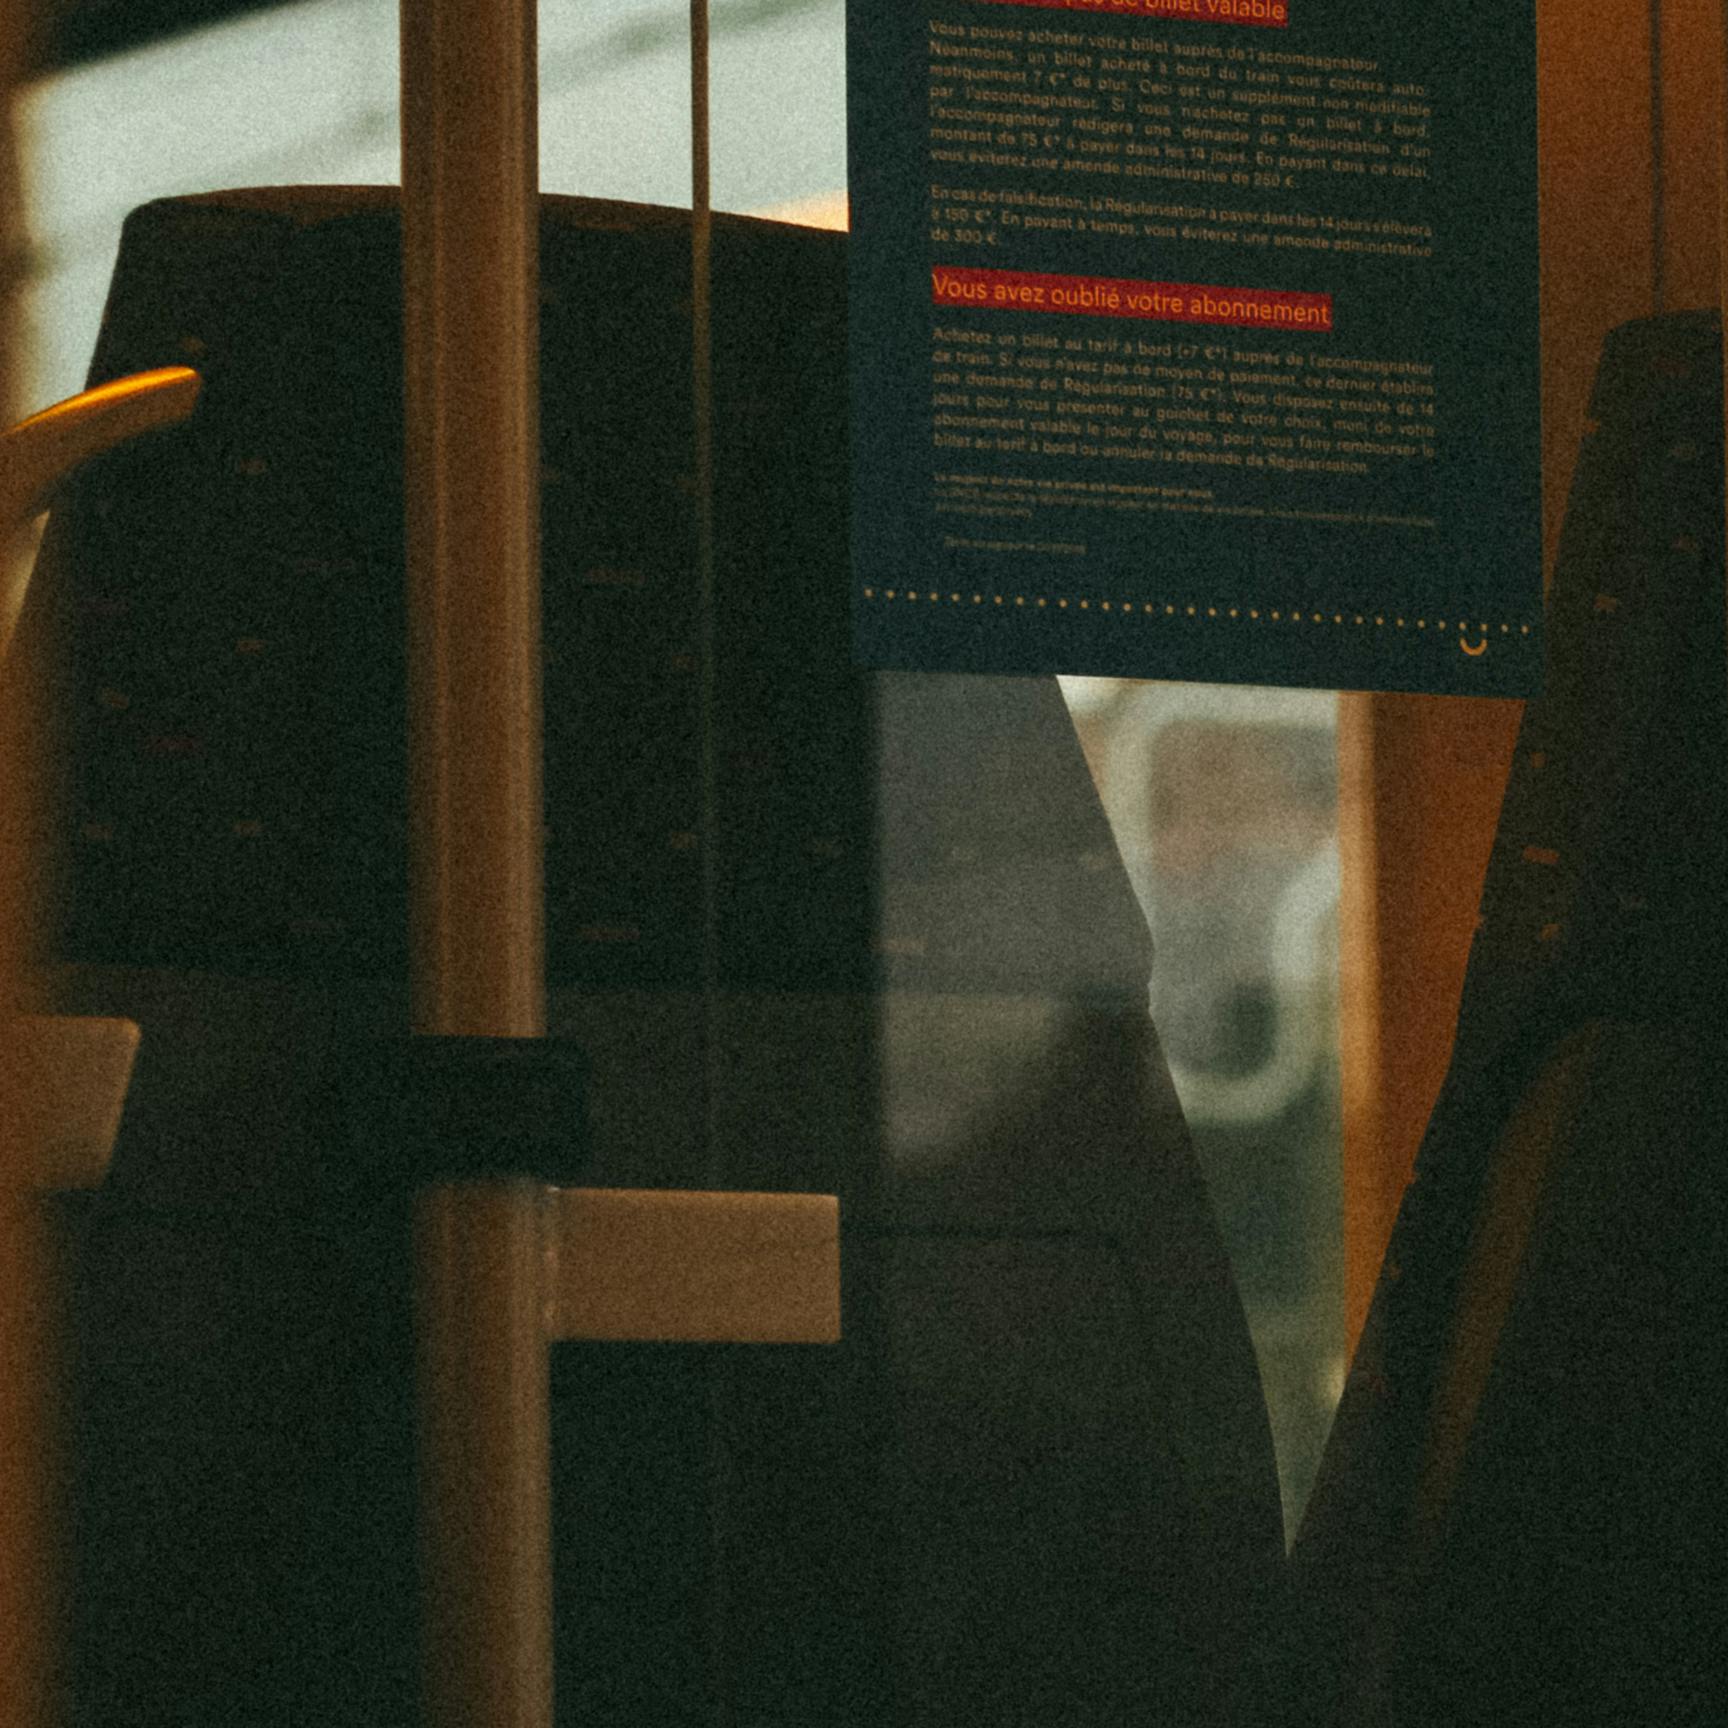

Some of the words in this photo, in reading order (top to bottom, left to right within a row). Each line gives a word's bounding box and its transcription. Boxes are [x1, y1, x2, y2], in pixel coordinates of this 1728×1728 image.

[1207, 0, 1285, 19] valable
[931, 271, 987, 299] Vous
[993, 283, 1044, 304] avez
[1050, 282, 1119, 309] oublié
[1126, 287, 1183, 314] votre
[1189, 291, 1330, 324] abonnement
